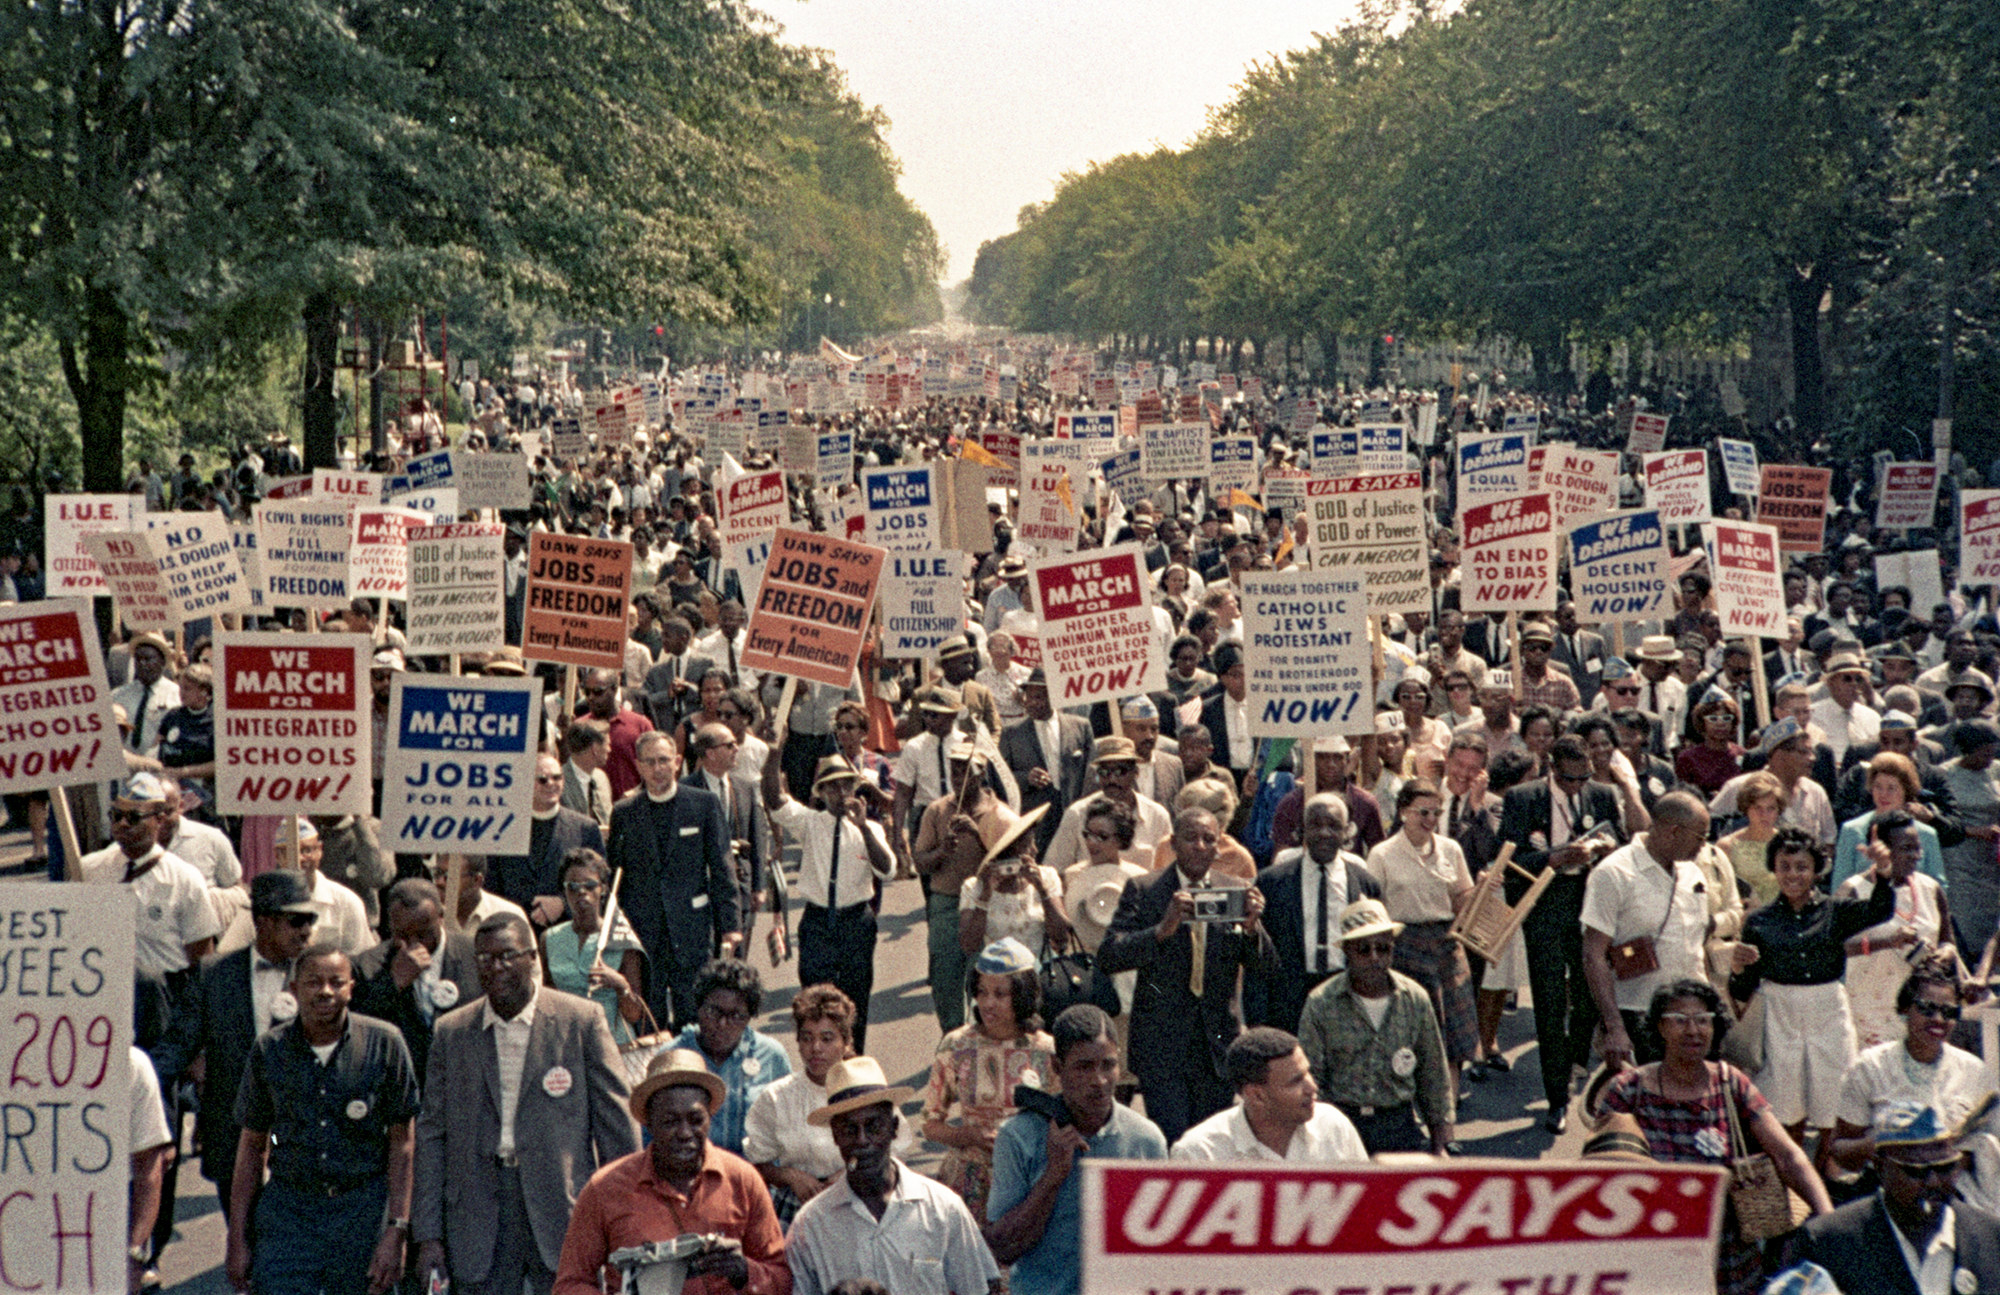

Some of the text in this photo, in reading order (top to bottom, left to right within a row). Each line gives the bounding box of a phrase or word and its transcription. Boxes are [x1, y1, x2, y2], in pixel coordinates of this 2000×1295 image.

[1074, 424, 1112, 433] MARCH
[1163, 427, 1204, 438] BAPTIST
[1316, 441, 1356, 451] MARCH
[1361, 437, 1400, 446] MARCH
[1479, 440, 1505, 456] WE
[1213, 448, 1252, 456] MARCH
[1464, 449, 1523, 471] DEMAND
[414, 463, 449, 477] MARCH
[1564, 456, 1595, 473] NO
[1663, 454, 1686, 470] WE
[888, 474, 908, 486] WE
[1469, 474, 1518, 485] EQUAL
[1650, 461, 1703, 485] DEMAND
[1890, 475, 1933, 485] MARCH
[324, 477, 373, 496] I.U.E.
[737, 478, 763, 497] WE
[872, 484, 927, 503] MARCH
[1310, 479, 1356, 495] UAW
[1357, 473, 1420, 491] SAYS:
[1565, 474, 1608, 495] DOUGH
[1763, 482, 1806, 498] JOBS
[1567, 492, 1598, 506] HELP
[59, 503, 119, 521] I.U.E.
[265, 511, 345, 527] CIVIL RIGHTS
[1315, 499, 1368, 521] GOD of
[1490, 500, 1524, 521] WE
[1760, 502, 1823, 518] FREEDOM
[730, 515, 781, 529] DECENT
[876, 513, 928, 532] JOBS
[1469, 511, 1549, 544] DEMAND
[1599, 517, 1633, 539] WE
[166, 527, 203, 547] NO
[877, 531, 927, 541] FOR ALL
[1317, 521, 1371, 543] GOD of
[1735, 530, 1755, 545] WE
[1969, 535, 1992, 546] AN
[179, 540, 231, 565] DOUGH
[288, 537, 321, 549] FULL
[540, 540, 623, 560] UAW SAYS
[783, 537, 826, 557] UAW
[829, 545, 874, 567] SAYS
[1578, 527, 1660, 561] DEMAND
[1721, 543, 1772, 562] MARCH
[268, 549, 345, 562] EMPLOYMENT
[413, 543, 455, 563] GOD of
[1318, 549, 1421, 568] CAN AMERICA
[1473, 548, 1549, 563] AN END
[170, 562, 226, 585] TO HELP
[533, 557, 624, 589] JOBS and
[894, 558, 953, 577] I.U.E.
[1070, 562, 1103, 581] WE
[1473, 565, 1548, 581] TO BIAS
[1587, 561, 1658, 578] DECENT
[1737, 559, 1759, 569] FOR
[195, 572, 237, 593] CROW
[413, 567, 455, 583] GOD of
[769, 557, 870, 598] JOBS and
[1725, 571, 1775, 587] EFFECTIVE
[269, 577, 346, 597] FREEDOM
[912, 586, 934, 596] FOR
[1047, 574, 1133, 606] MARCH
[1244, 581, 1360, 596] WE MARCH TOGETHER
[1374, 587, 1429, 606] HOUR?
[1476, 580, 1548, 601] NOW!
[1582, 579, 1667, 596] HOUSING
[1718, 582, 1780, 599] CIVIL RIGHTS
[184, 590, 230, 611] GROW
[412, 592, 498, 608] CAN AMERICA
[530, 586, 623, 618] FREEDOM
[759, 587, 864, 630] FREEDOM
[910, 600, 936, 615] FULL
[1076, 599, 1111, 613] FOR
[1256, 600, 1347, 616] CATHOLIC
[1590, 593, 1664, 614] NOW!
[1736, 596, 1766, 609] LAWS
[411, 610, 499, 628] DENY FREEDOM
[561, 617, 589, 629] FOR
[889, 616, 958, 632] CITIZENSHIP
[1064, 612, 1129, 633] HIGHER
[1273, 617, 1328, 631] JEWS
[1728, 609, 1780, 629] NOW!
[410, 628, 502, 646] IN THIS HOUR?
[529, 625, 619, 653] Every American
[790, 624, 821, 639] FOR
[1046, 620, 1152, 650] MINIMUM WAGES
[1254, 632, 1353, 649] PROTESTANT
[0, 637, 77, 668] ARCH
[750, 628, 850, 666] Every American
[1053, 641, 1119, 662] COVERAGE
[1125, 636, 1150, 649] FOR
[270, 650, 310, 669] WE
[1059, 648, 1148, 674] ALL WORKERS
[1269, 654, 1339, 665] FOR DIGNITY
[2, 667, 48, 682] FOR
[234, 671, 346, 694] MARCH
[1064, 661, 1149, 699] NOW!
[1253, 667, 1359, 680] AND BROTHERHOOD
[1250, 681, 1363, 693] OF ALL MEN UNDER GOD
[269, 696, 313, 708] FOR
[447, 692, 486, 712] WE
[1262, 691, 1360, 724] NOW!
[226, 717, 358, 737] INTEGRATED
[408, 710, 519, 737] MARCH
[441, 737, 485, 750] FOR
[0, 739, 101, 780] NOW!
[227, 746, 357, 766] SCHOOLS
[404, 761, 514, 790] JOBS
[236, 772, 352, 802] NOW!
[406, 793, 508, 807] FOR ALL
[399, 812, 516, 842] NOW!
[9, 1011, 113, 1090] 209
[1122, 1174, 1706, 1247] UAW SAYS:
